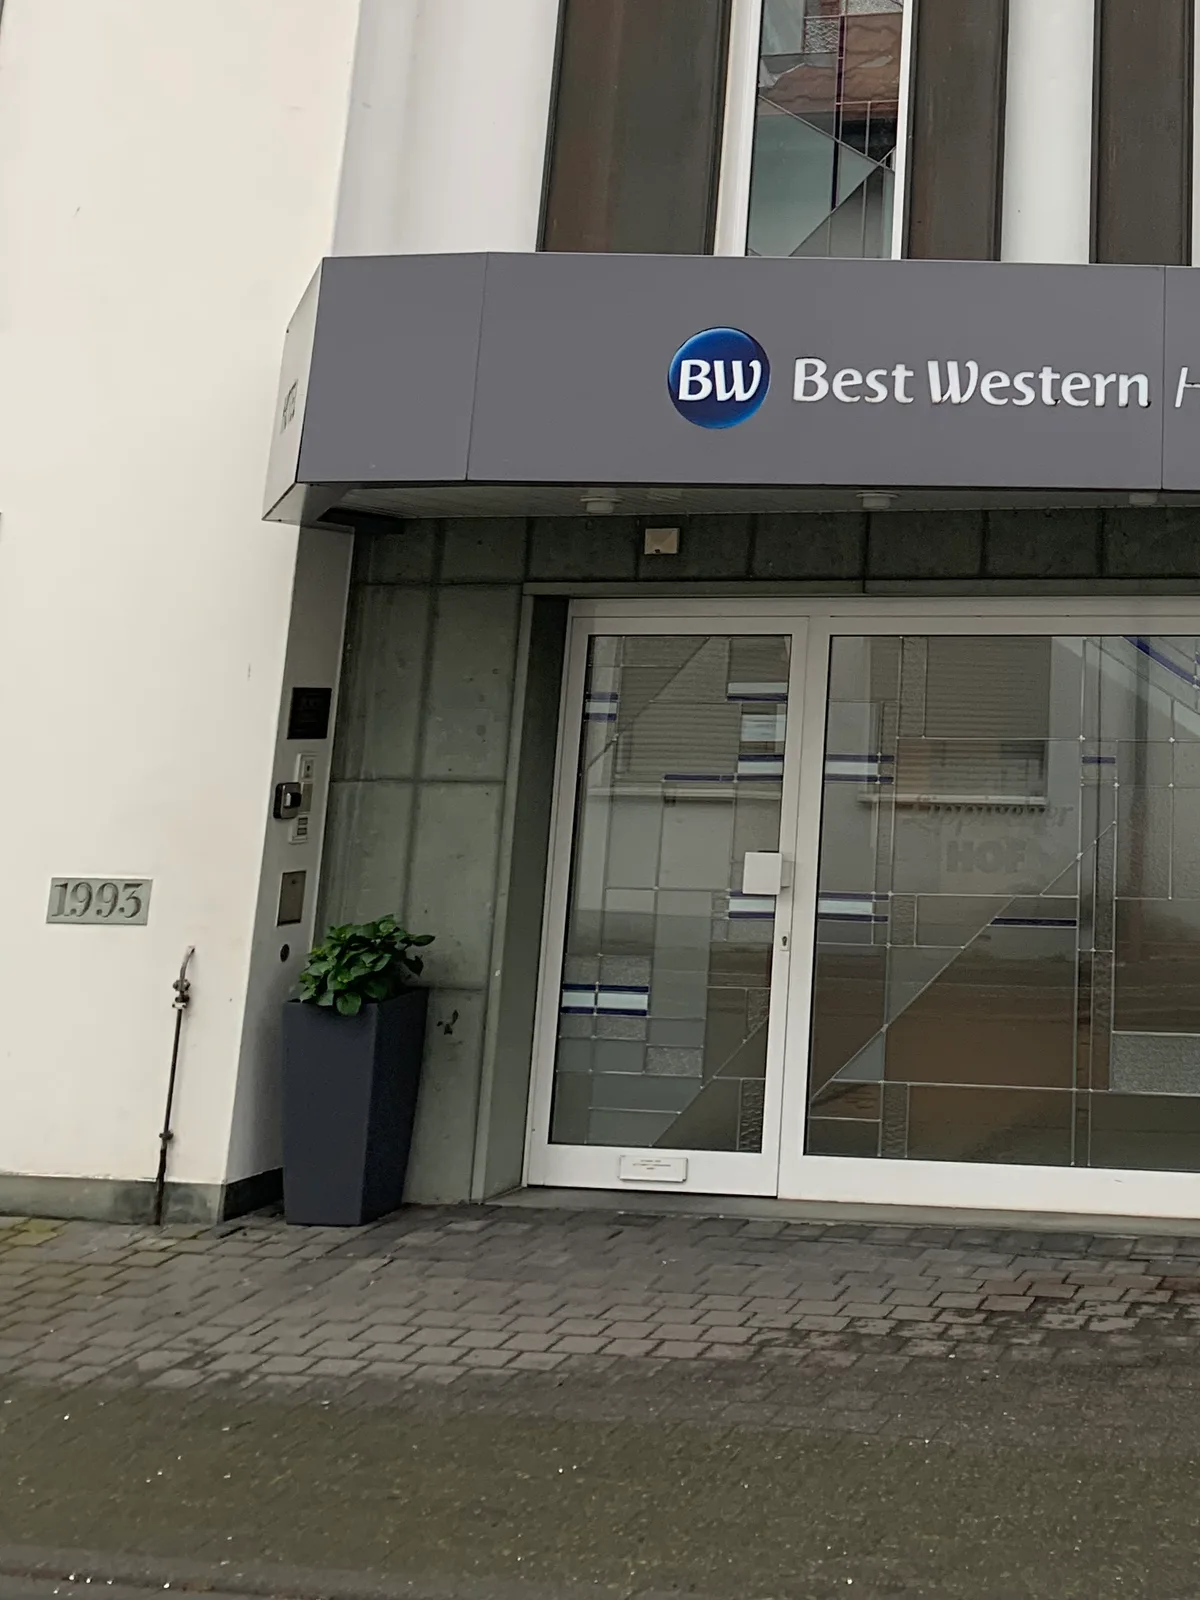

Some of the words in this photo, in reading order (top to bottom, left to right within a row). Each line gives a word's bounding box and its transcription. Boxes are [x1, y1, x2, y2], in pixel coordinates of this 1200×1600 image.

[677, 358, 762, 402] BW
[792, 356, 914, 403] Best
[926, 359, 1151, 408] Western
[51, 881, 143, 918] 1993
